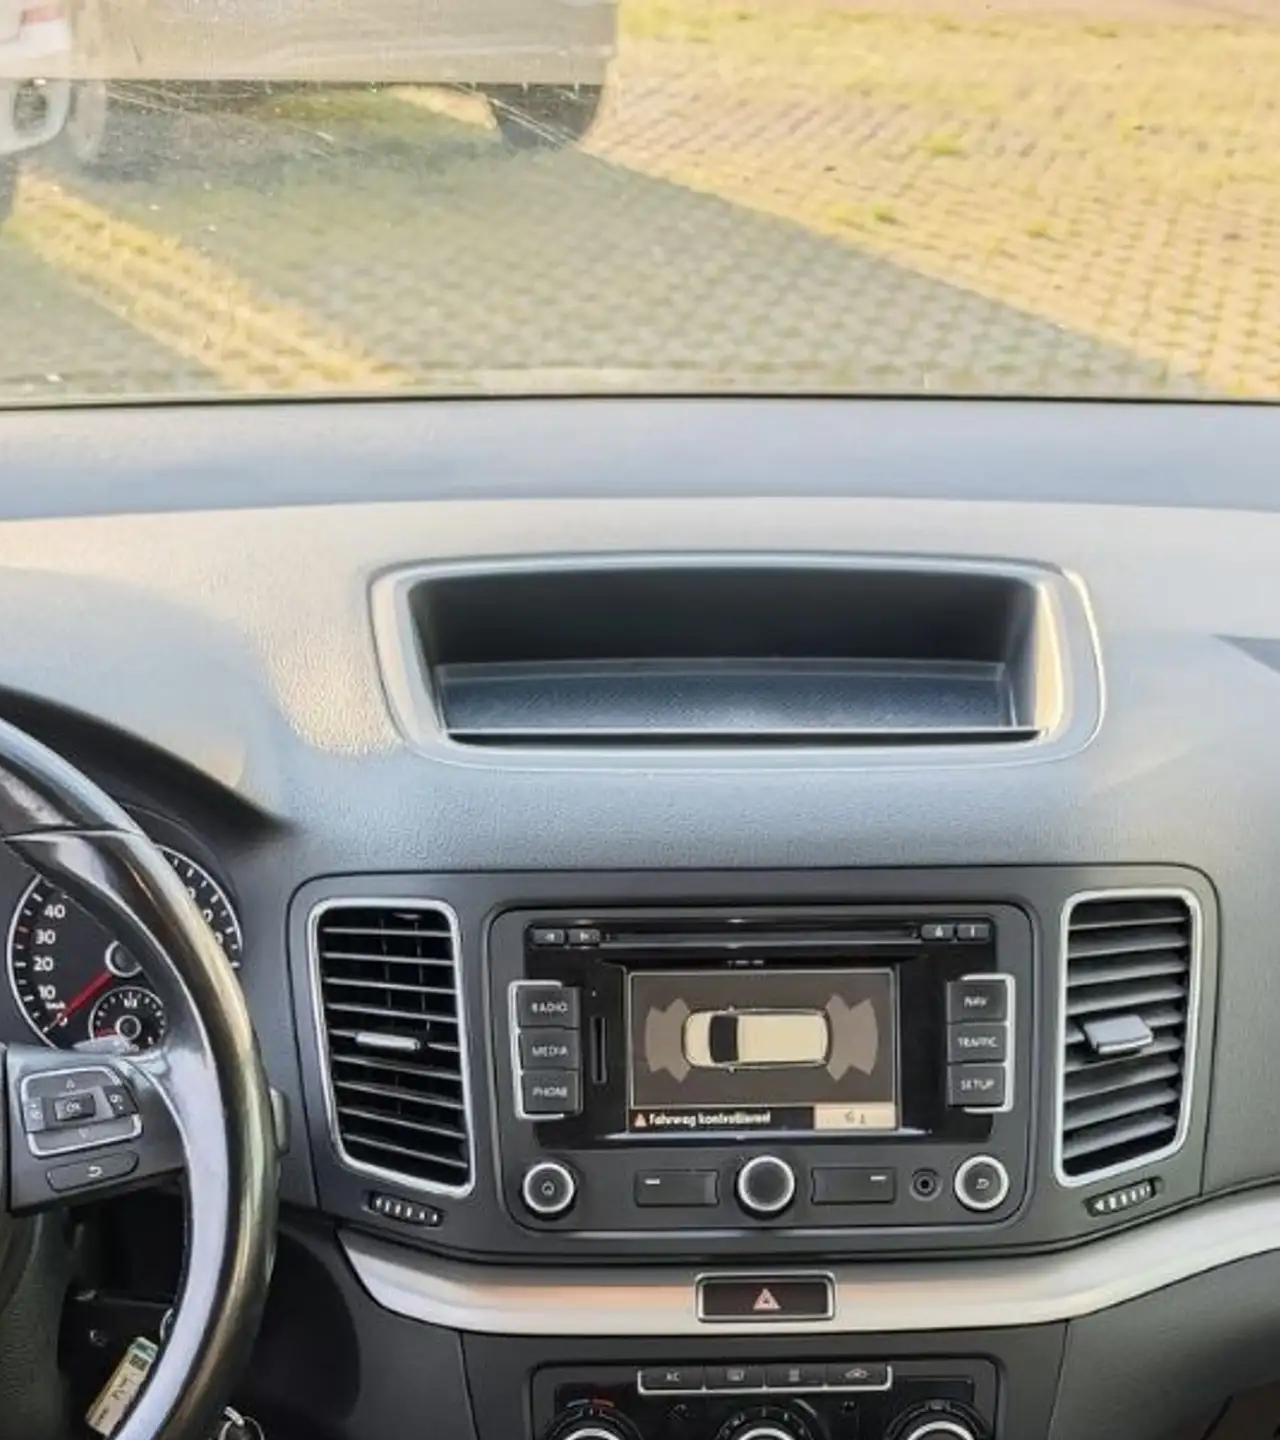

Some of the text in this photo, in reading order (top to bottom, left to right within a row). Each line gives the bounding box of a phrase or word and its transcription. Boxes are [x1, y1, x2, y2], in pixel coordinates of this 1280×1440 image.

[44, 904, 66, 919] 40
[35, 930, 56, 945] 30
[33, 957, 54, 971] 20
[38, 984, 56, 999] 10
[531, 1002, 569, 1013] RADIO
[532, 1045, 569, 1057] MEDIA
[960, 1078, 996, 1091] SETUP
[532, 1086, 568, 1098] PHONE
